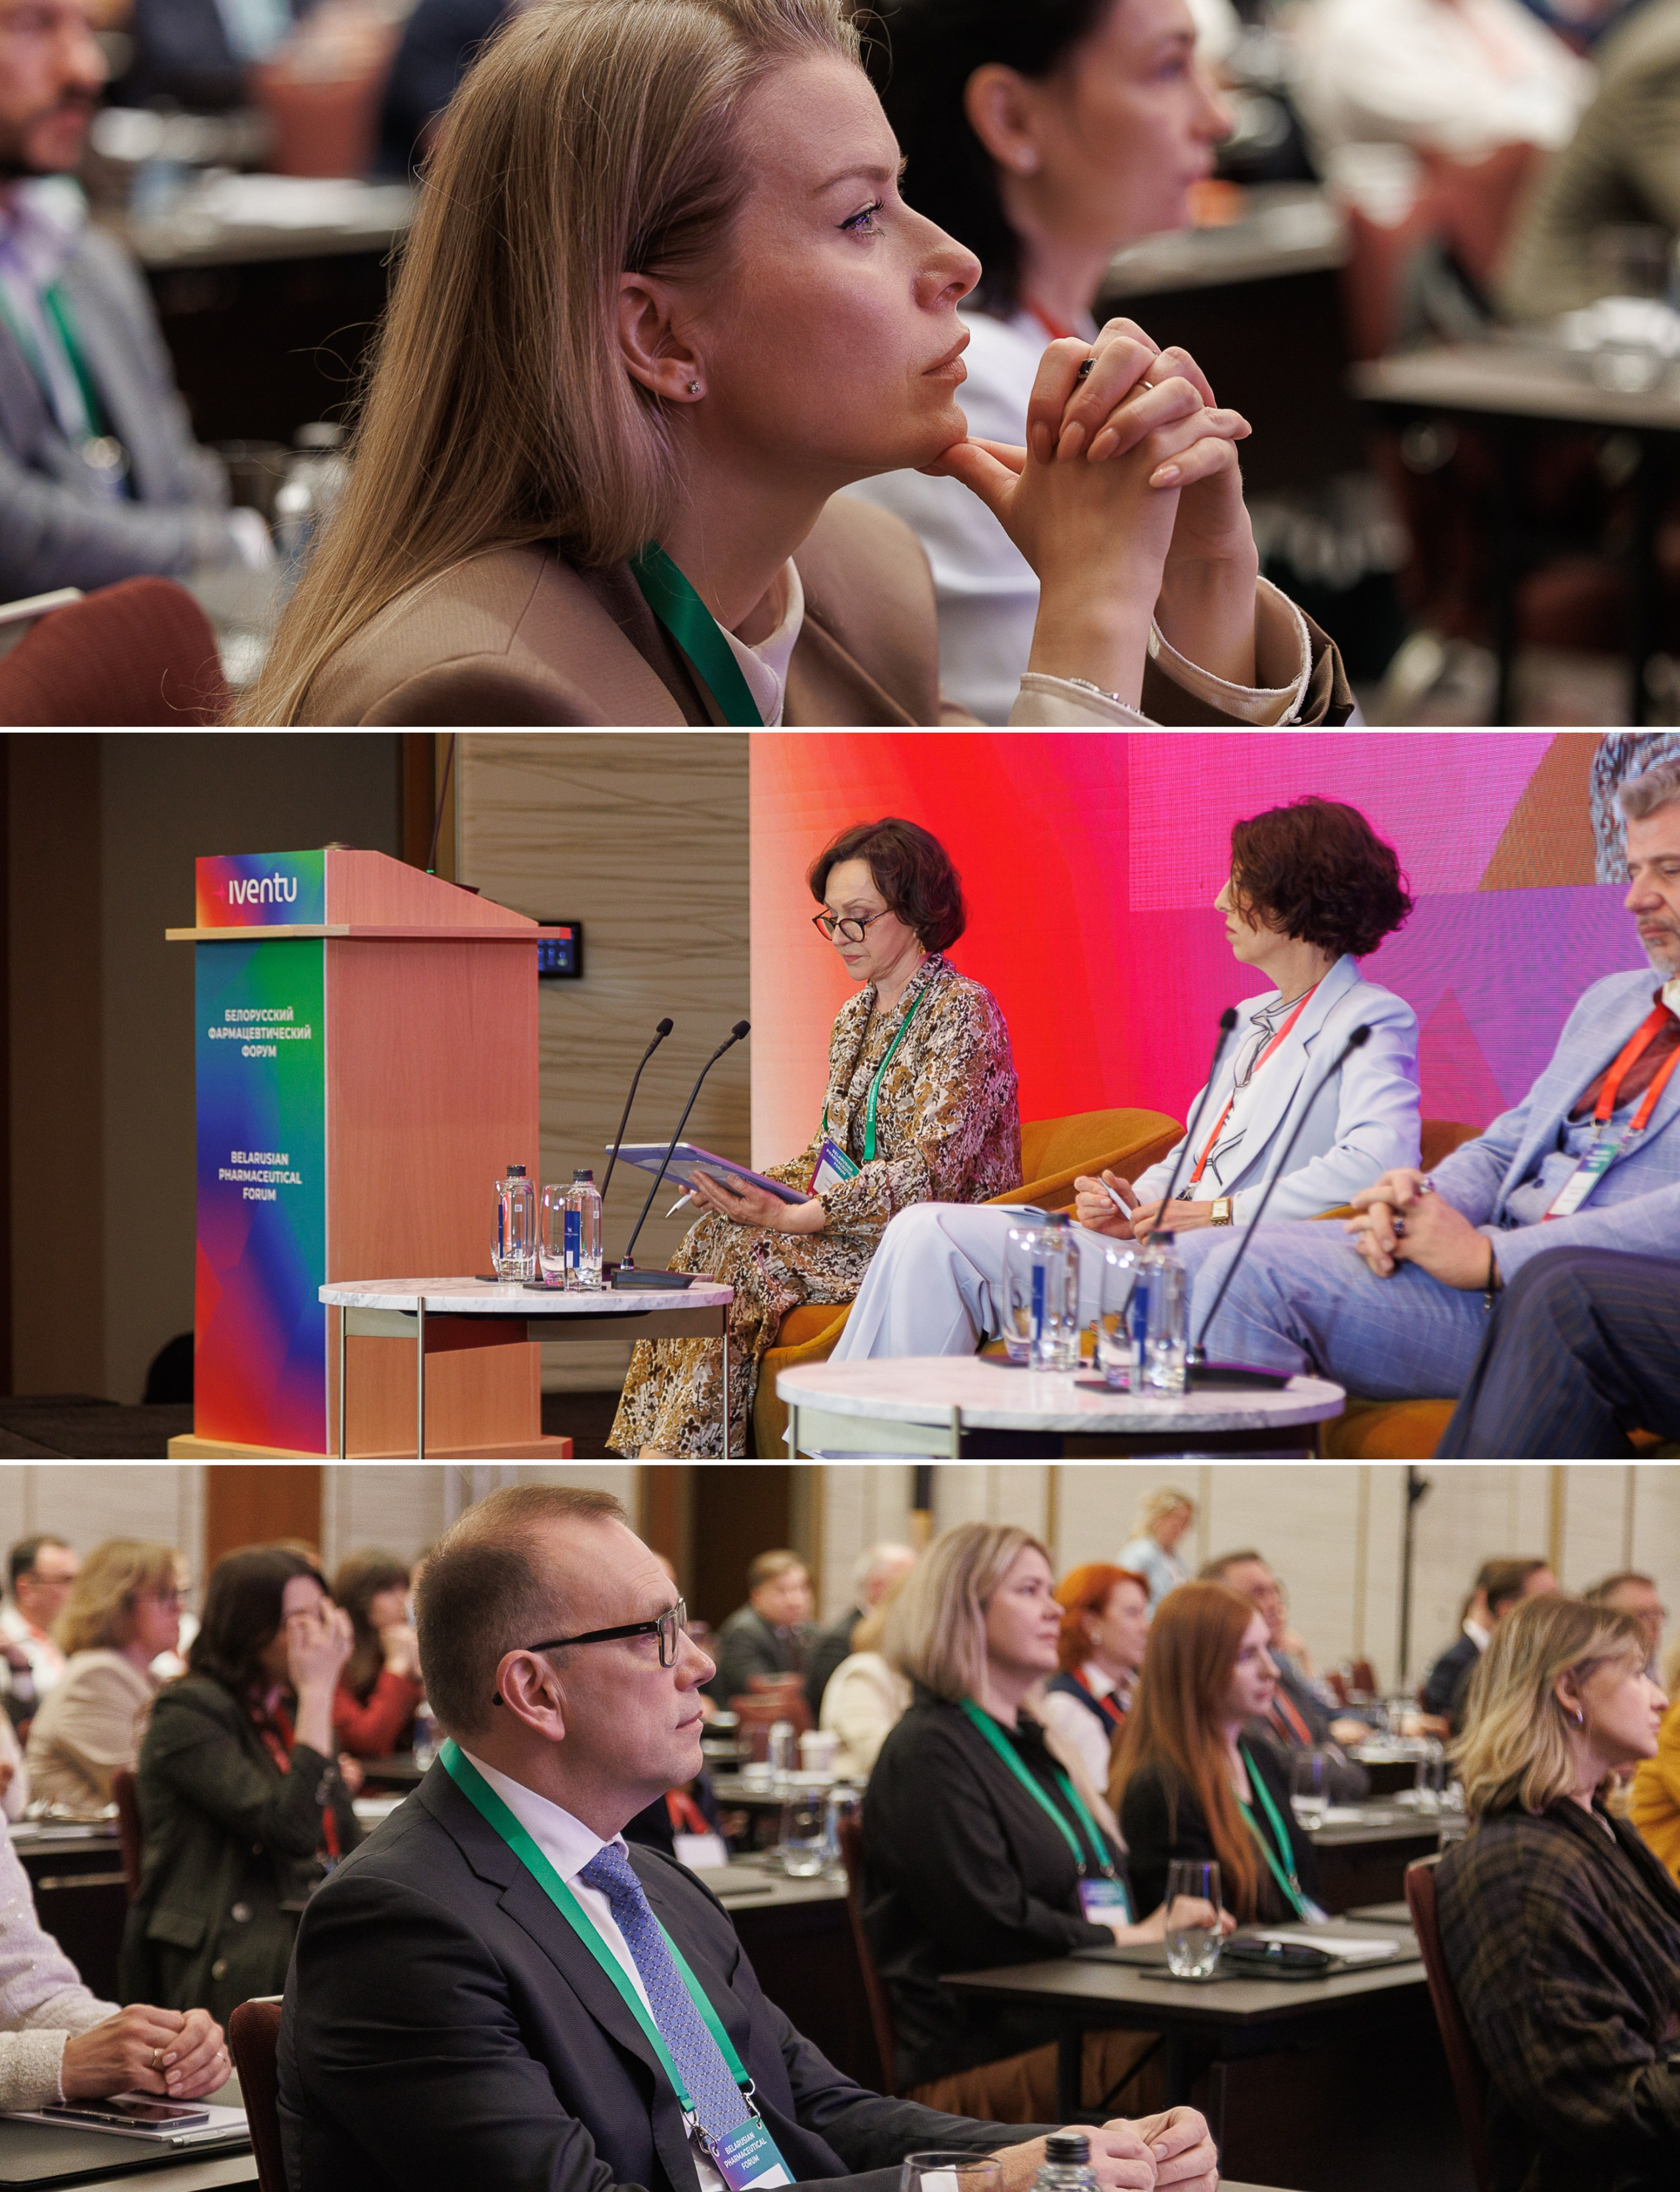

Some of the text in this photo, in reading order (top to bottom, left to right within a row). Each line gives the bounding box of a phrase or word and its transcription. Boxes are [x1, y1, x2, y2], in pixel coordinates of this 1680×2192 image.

[224, 1006, 294, 1022] БЕЛОРУССКИЙ
[207, 1024, 312, 1042] ФАРМАЦЕВТИЧЕСКИЙ
[241, 1045, 277, 1058] ФОРУМ
[230, 1150, 289, 1166] BELARUSIAN
[219, 1168, 303, 1185] PHARMACEUTICAL
[243, 1187, 276, 1201] FORUM
[724, 2132, 755, 2155] BELARUSIAN
[724, 2138, 767, 2168] PHARMACEUTICAL
[741, 2154, 759, 2170] FORUM
